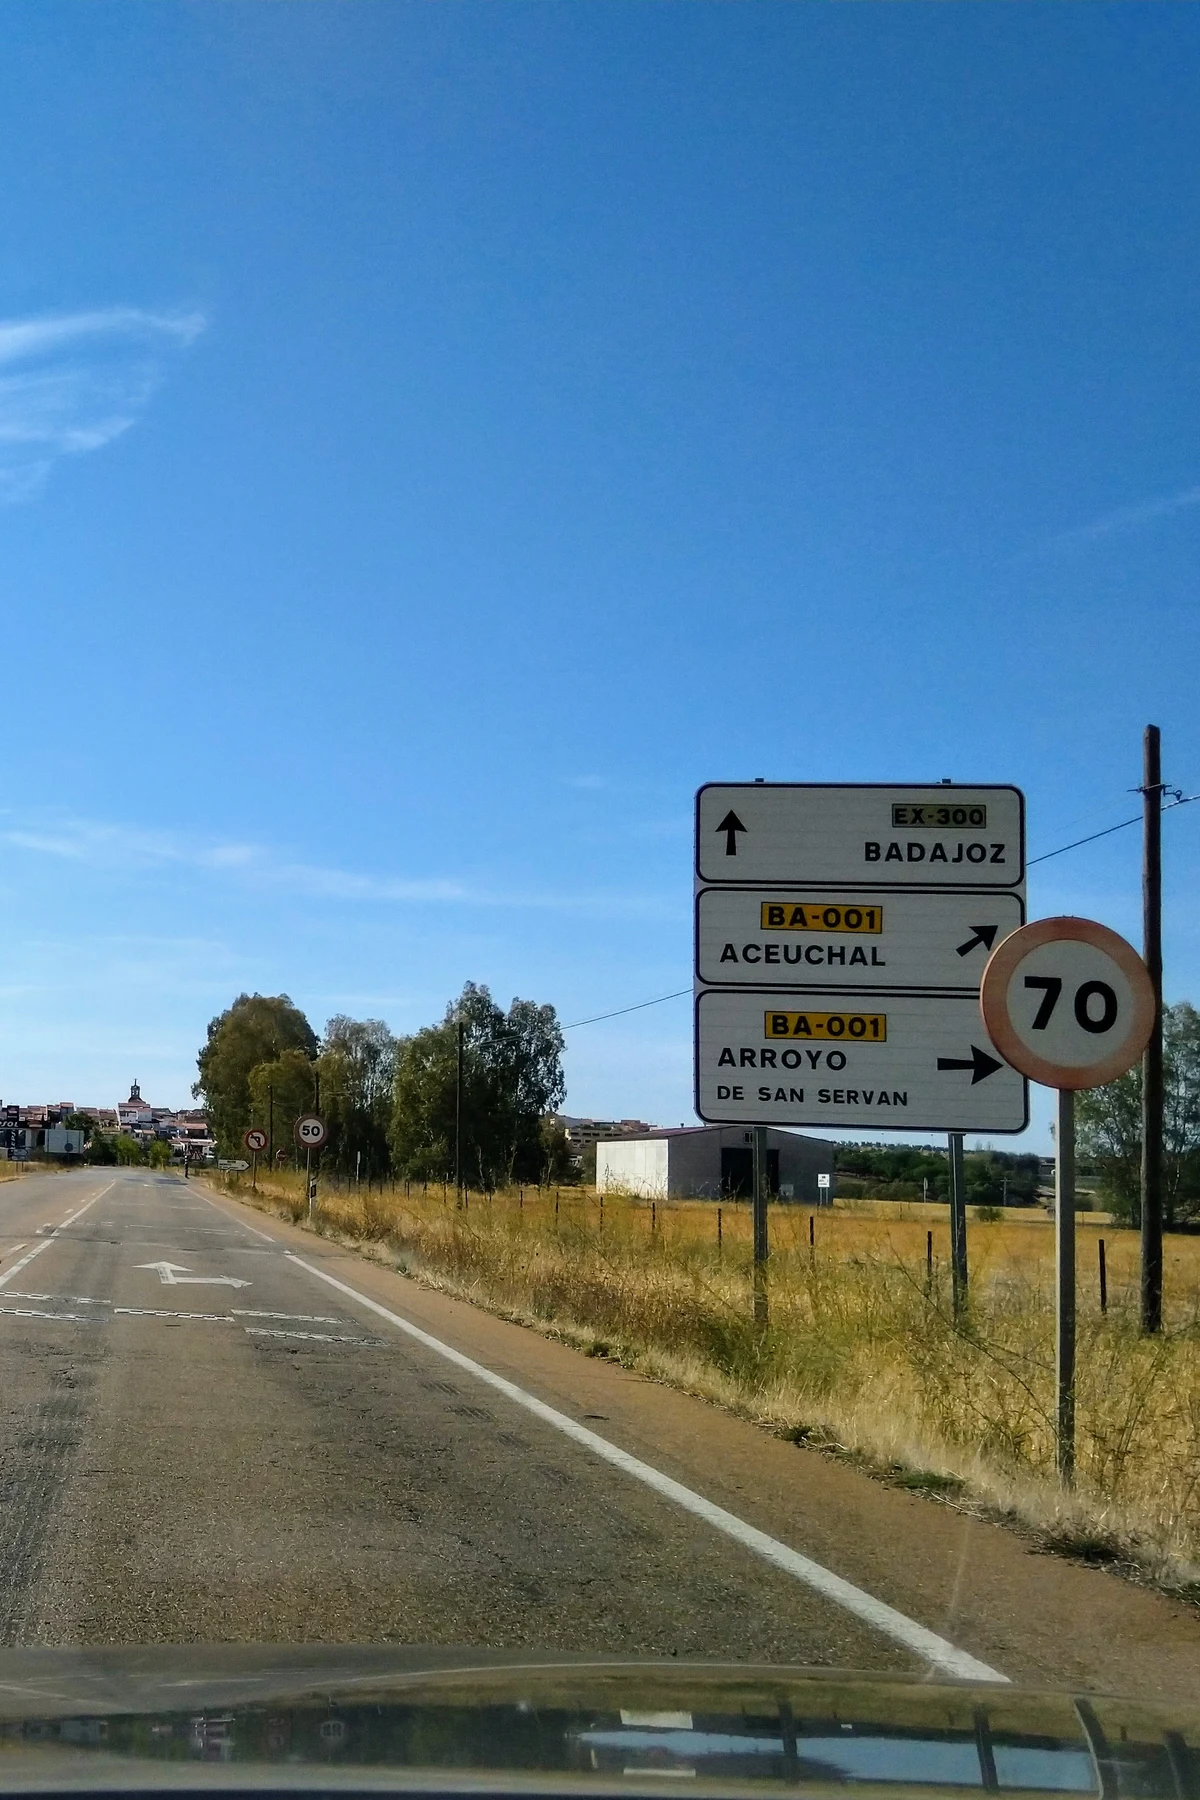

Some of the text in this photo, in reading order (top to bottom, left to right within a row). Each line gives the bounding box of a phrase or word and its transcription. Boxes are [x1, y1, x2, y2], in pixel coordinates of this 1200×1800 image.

[894, 807, 984, 826] EX-300
[864, 841, 1006, 864] BADAJOZ
[768, 905, 875, 930] BA-001
[719, 943, 886, 967] ACEUCHAL
[1024, 975, 1118, 1034] 70
[771, 1014, 879, 1038] BA-001
[717, 1047, 847, 1071] ARROYO
[717, 1085, 908, 1107] DE SAN SERVAN
[302, 1125, 320, 1136] 50
